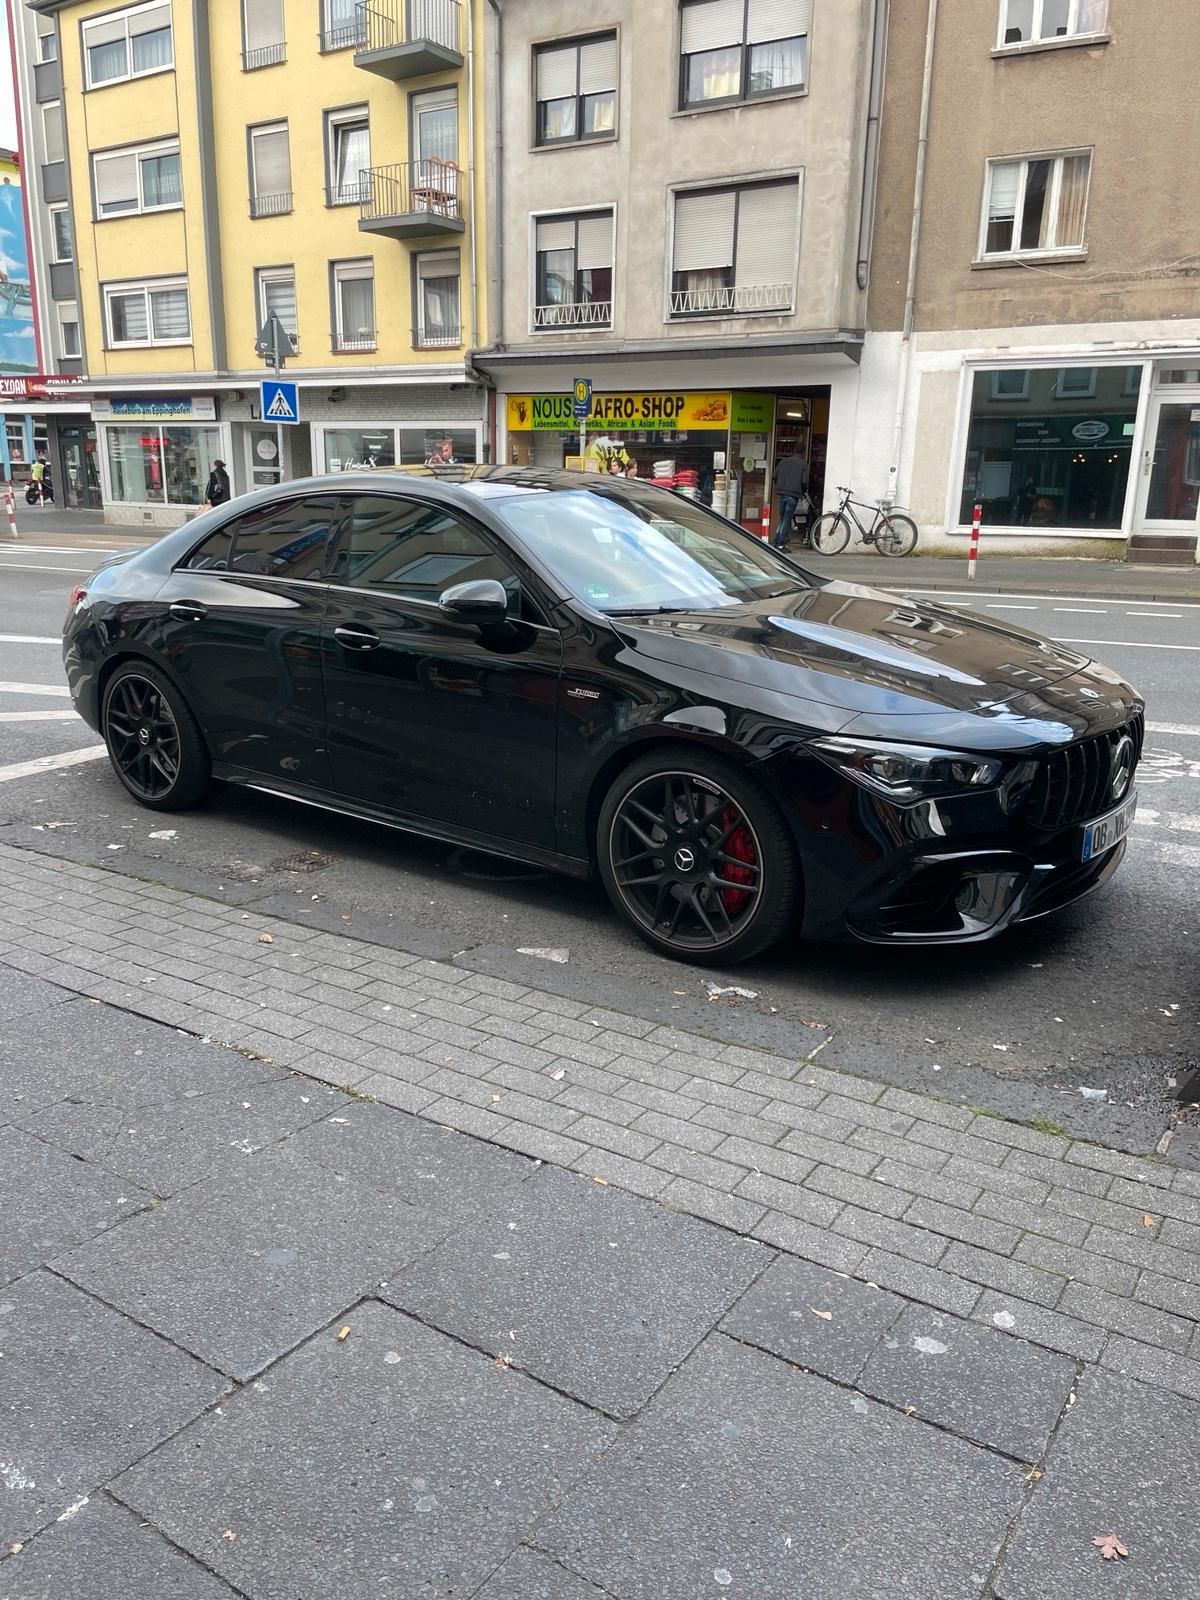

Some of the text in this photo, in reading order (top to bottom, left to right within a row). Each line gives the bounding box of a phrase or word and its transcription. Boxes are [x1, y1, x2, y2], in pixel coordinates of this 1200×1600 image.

[152, 404, 191, 416] Eppinghofen
[593, 396, 685, 418] AFRO-SHOP
[533, 420, 570, 429] Lebensmittel,
[607, 420, 628, 428] African
[631, 420, 636, 428] &
[639, 419, 656, 428] Asian
[659, 419, 677, 428] Foods
